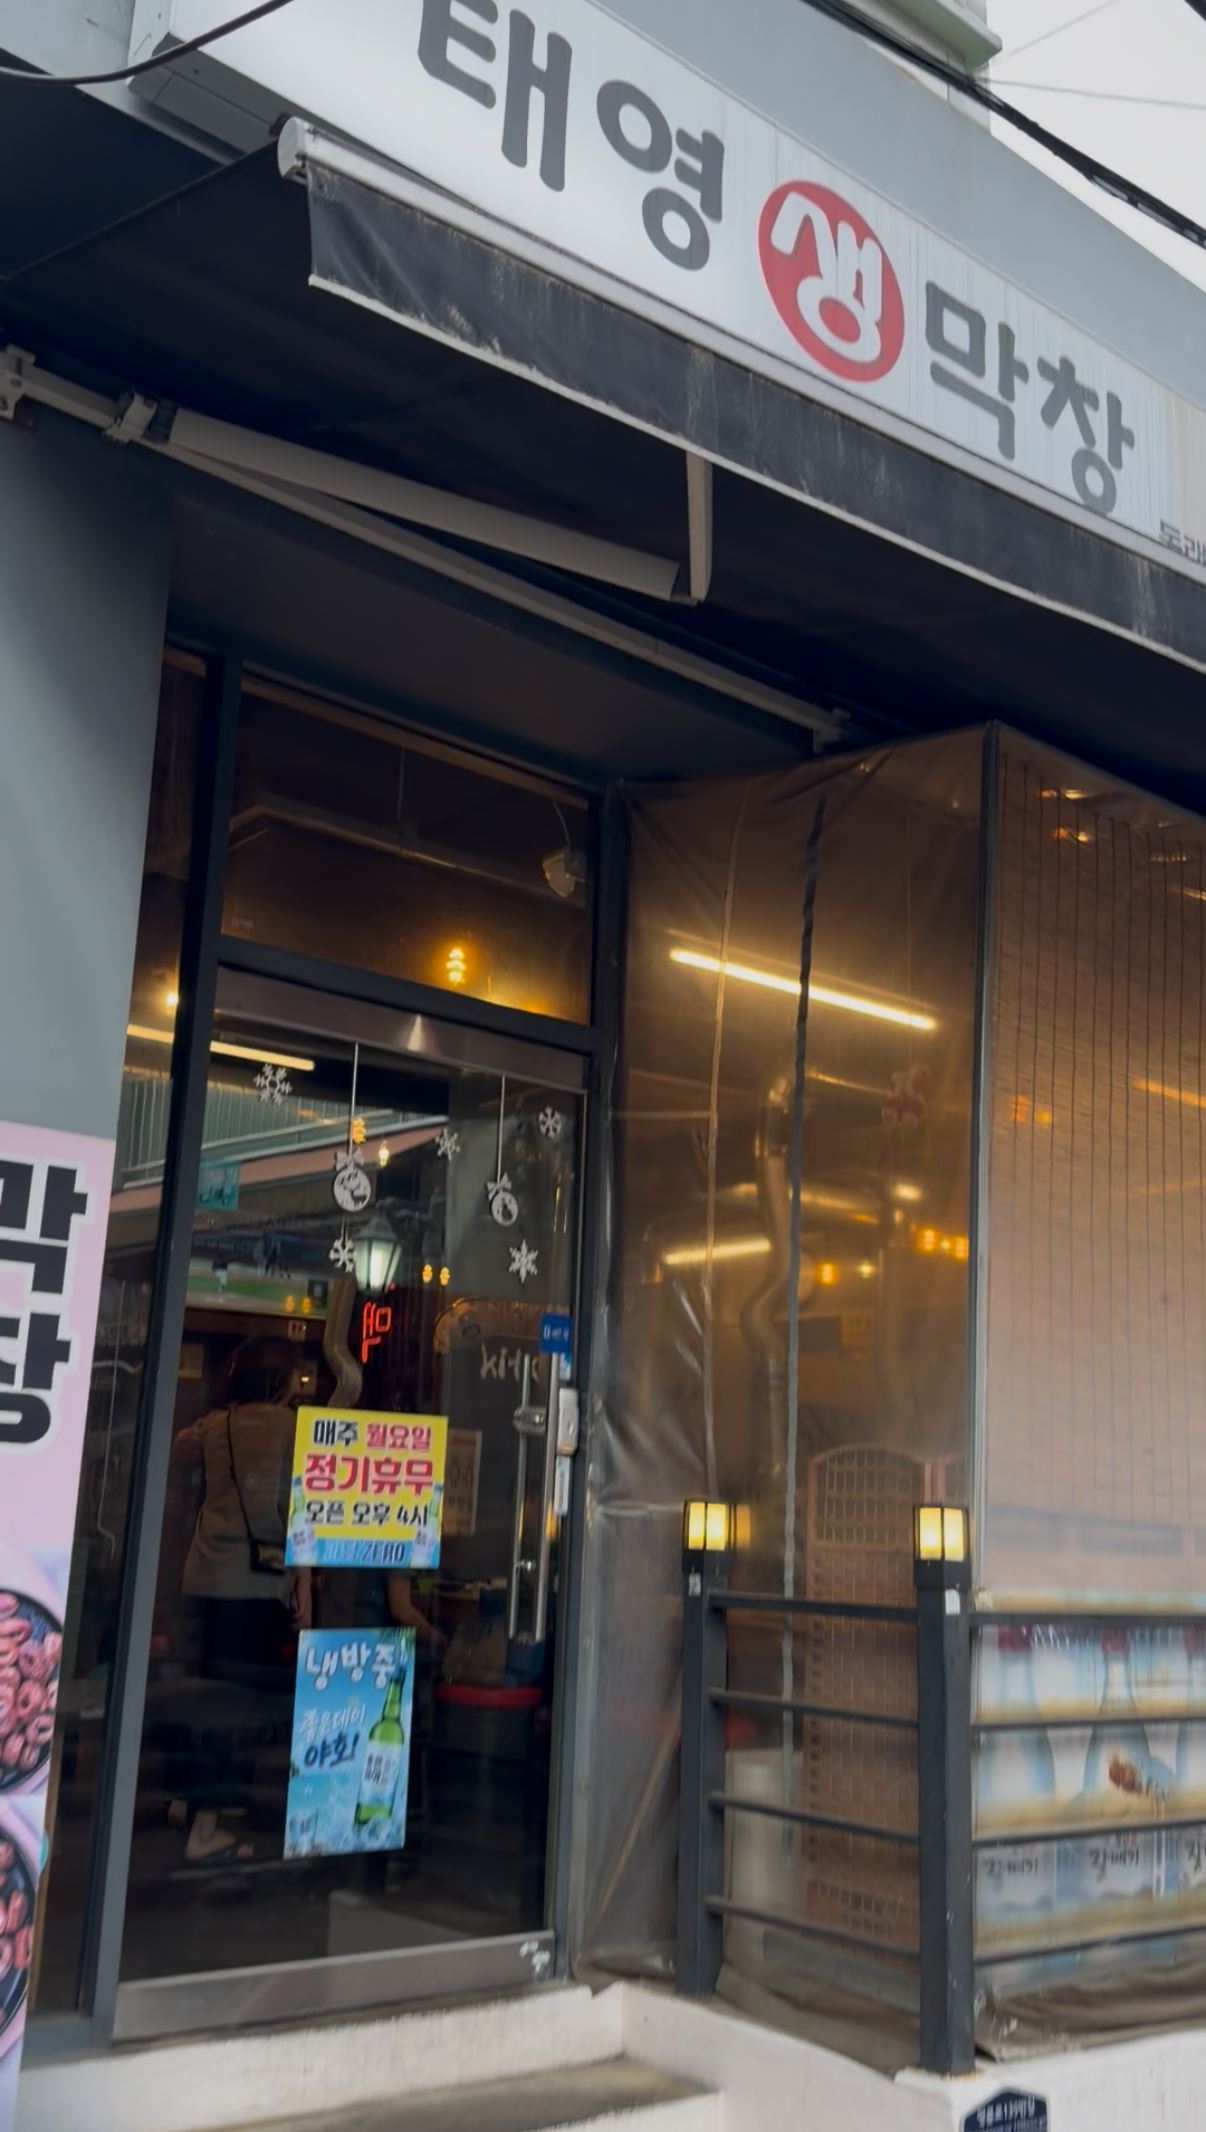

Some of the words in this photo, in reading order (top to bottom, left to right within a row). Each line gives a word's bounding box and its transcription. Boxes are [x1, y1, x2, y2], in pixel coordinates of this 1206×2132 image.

[419, 0, 724, 271] 태영
[769, 190, 884, 368] 생
[925, 280, 1136, 515] 막창
[313, 1419, 358, 1447] 매주
[365, 1422, 432, 1452] 월요일
[304, 1453, 434, 1497] 정기휴무
[304, 1500, 345, 1526] 오픈
[351, 1502, 391, 1527] 오후
[396, 1503, 429, 1528] 4시
